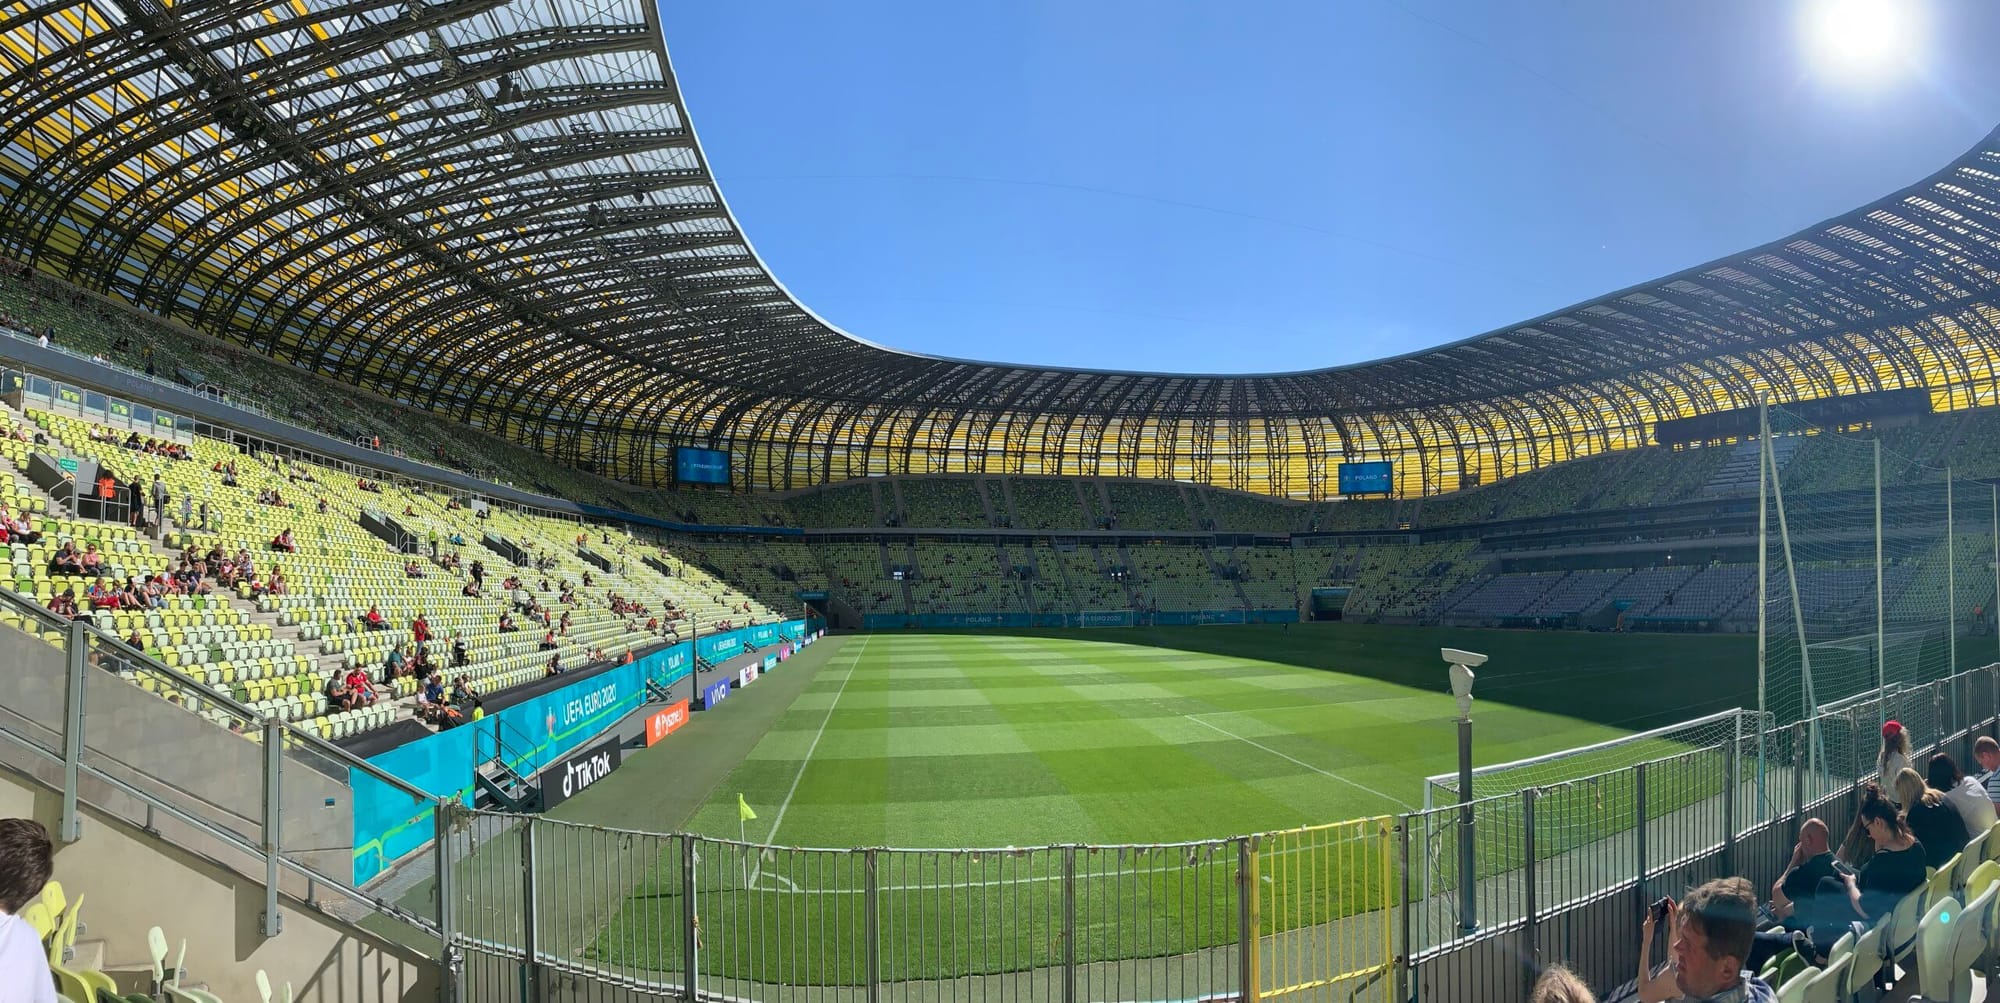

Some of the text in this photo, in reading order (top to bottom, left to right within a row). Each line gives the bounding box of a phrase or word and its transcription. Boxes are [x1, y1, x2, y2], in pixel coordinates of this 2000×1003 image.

[563, 683, 617, 726] UEFA EURO 2020
[575, 751, 611, 790] TikTok
